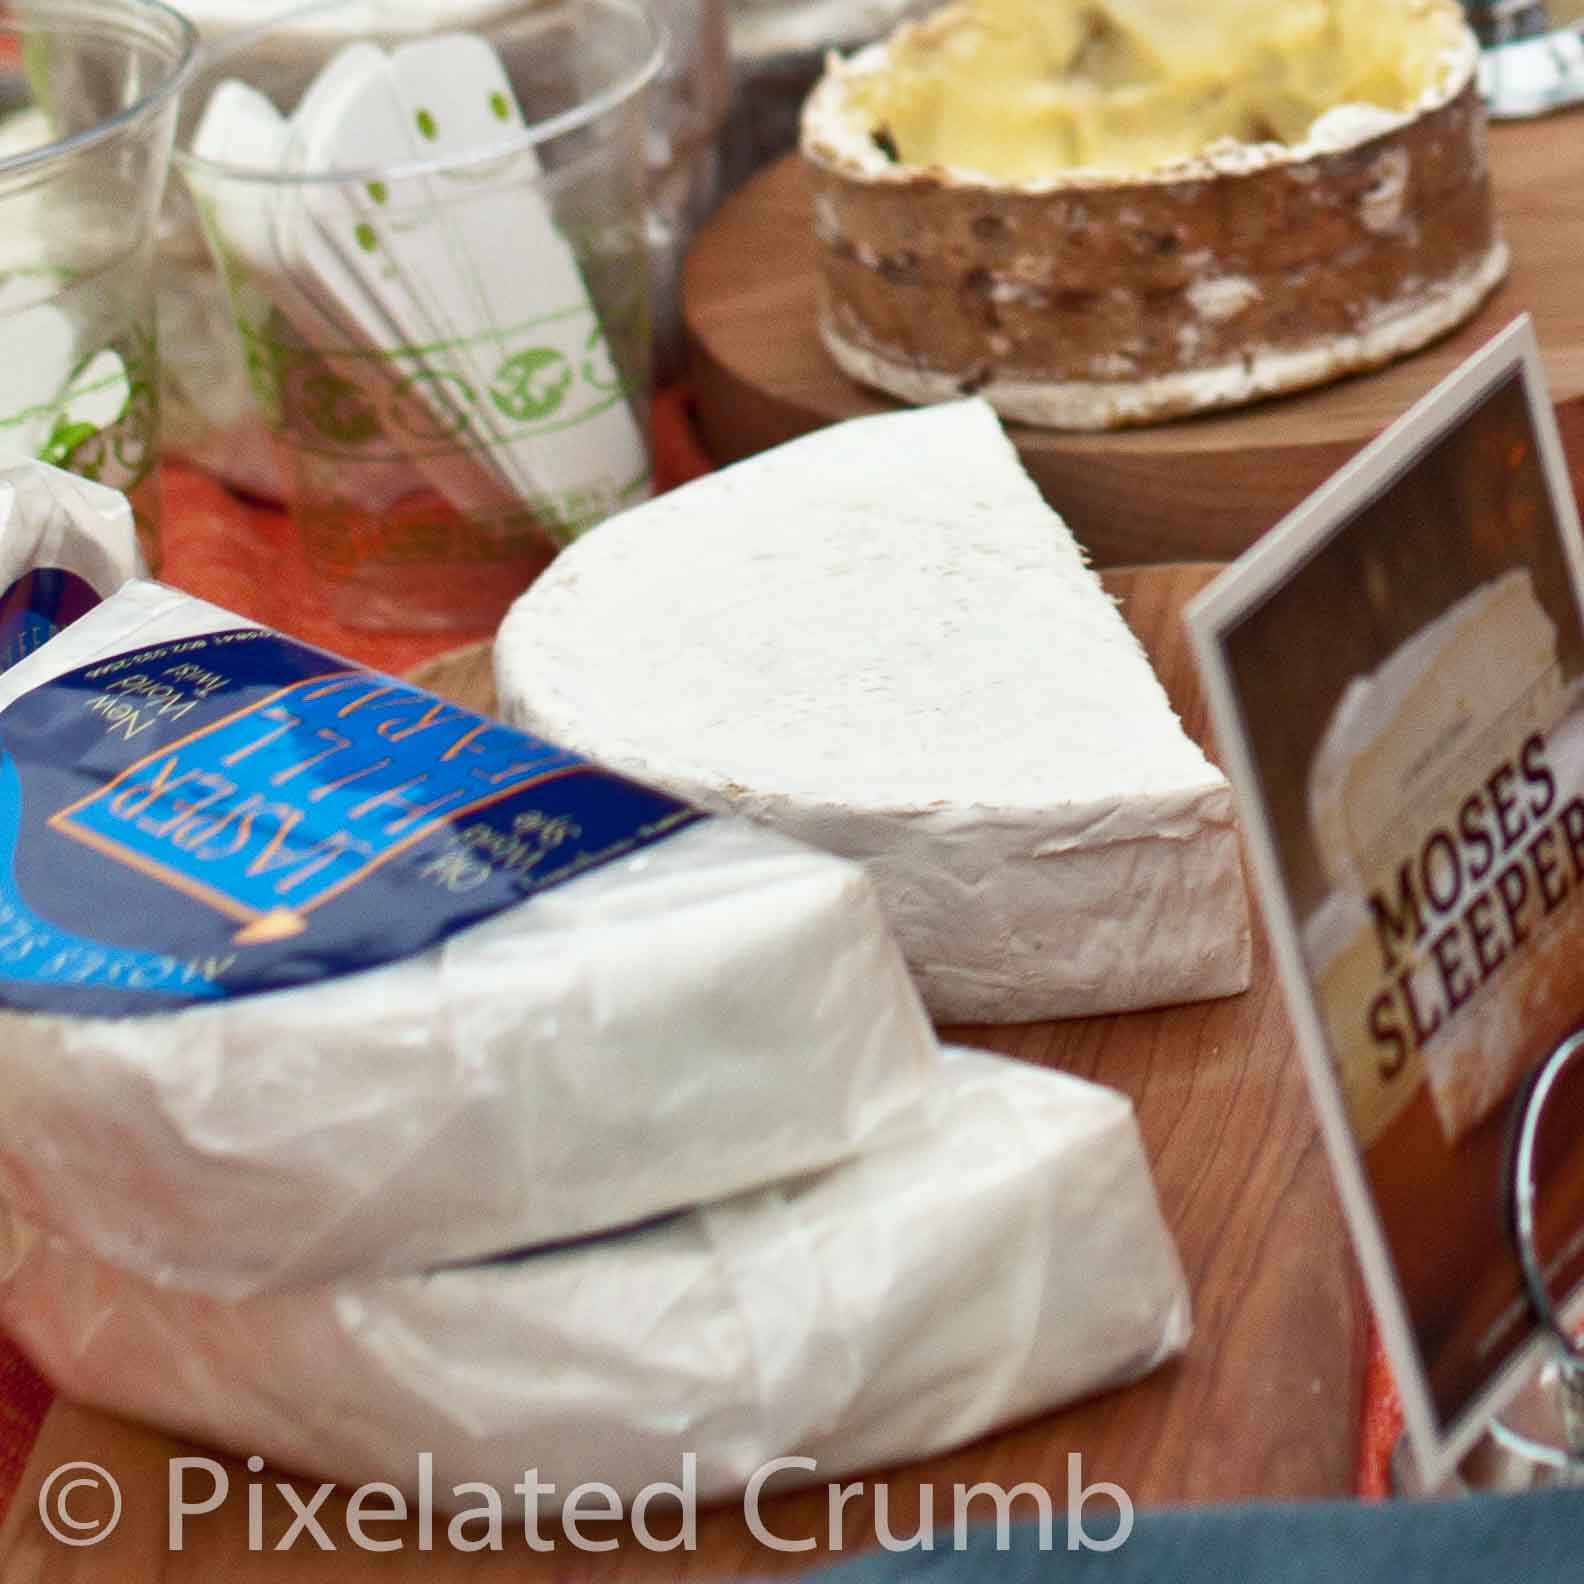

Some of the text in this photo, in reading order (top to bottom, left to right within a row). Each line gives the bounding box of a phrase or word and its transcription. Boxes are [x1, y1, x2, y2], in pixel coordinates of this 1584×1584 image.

[107, 756, 372, 894] JASPER
[221, 705, 466, 834] HILL
[1363, 734, 1559, 971] MOSES
